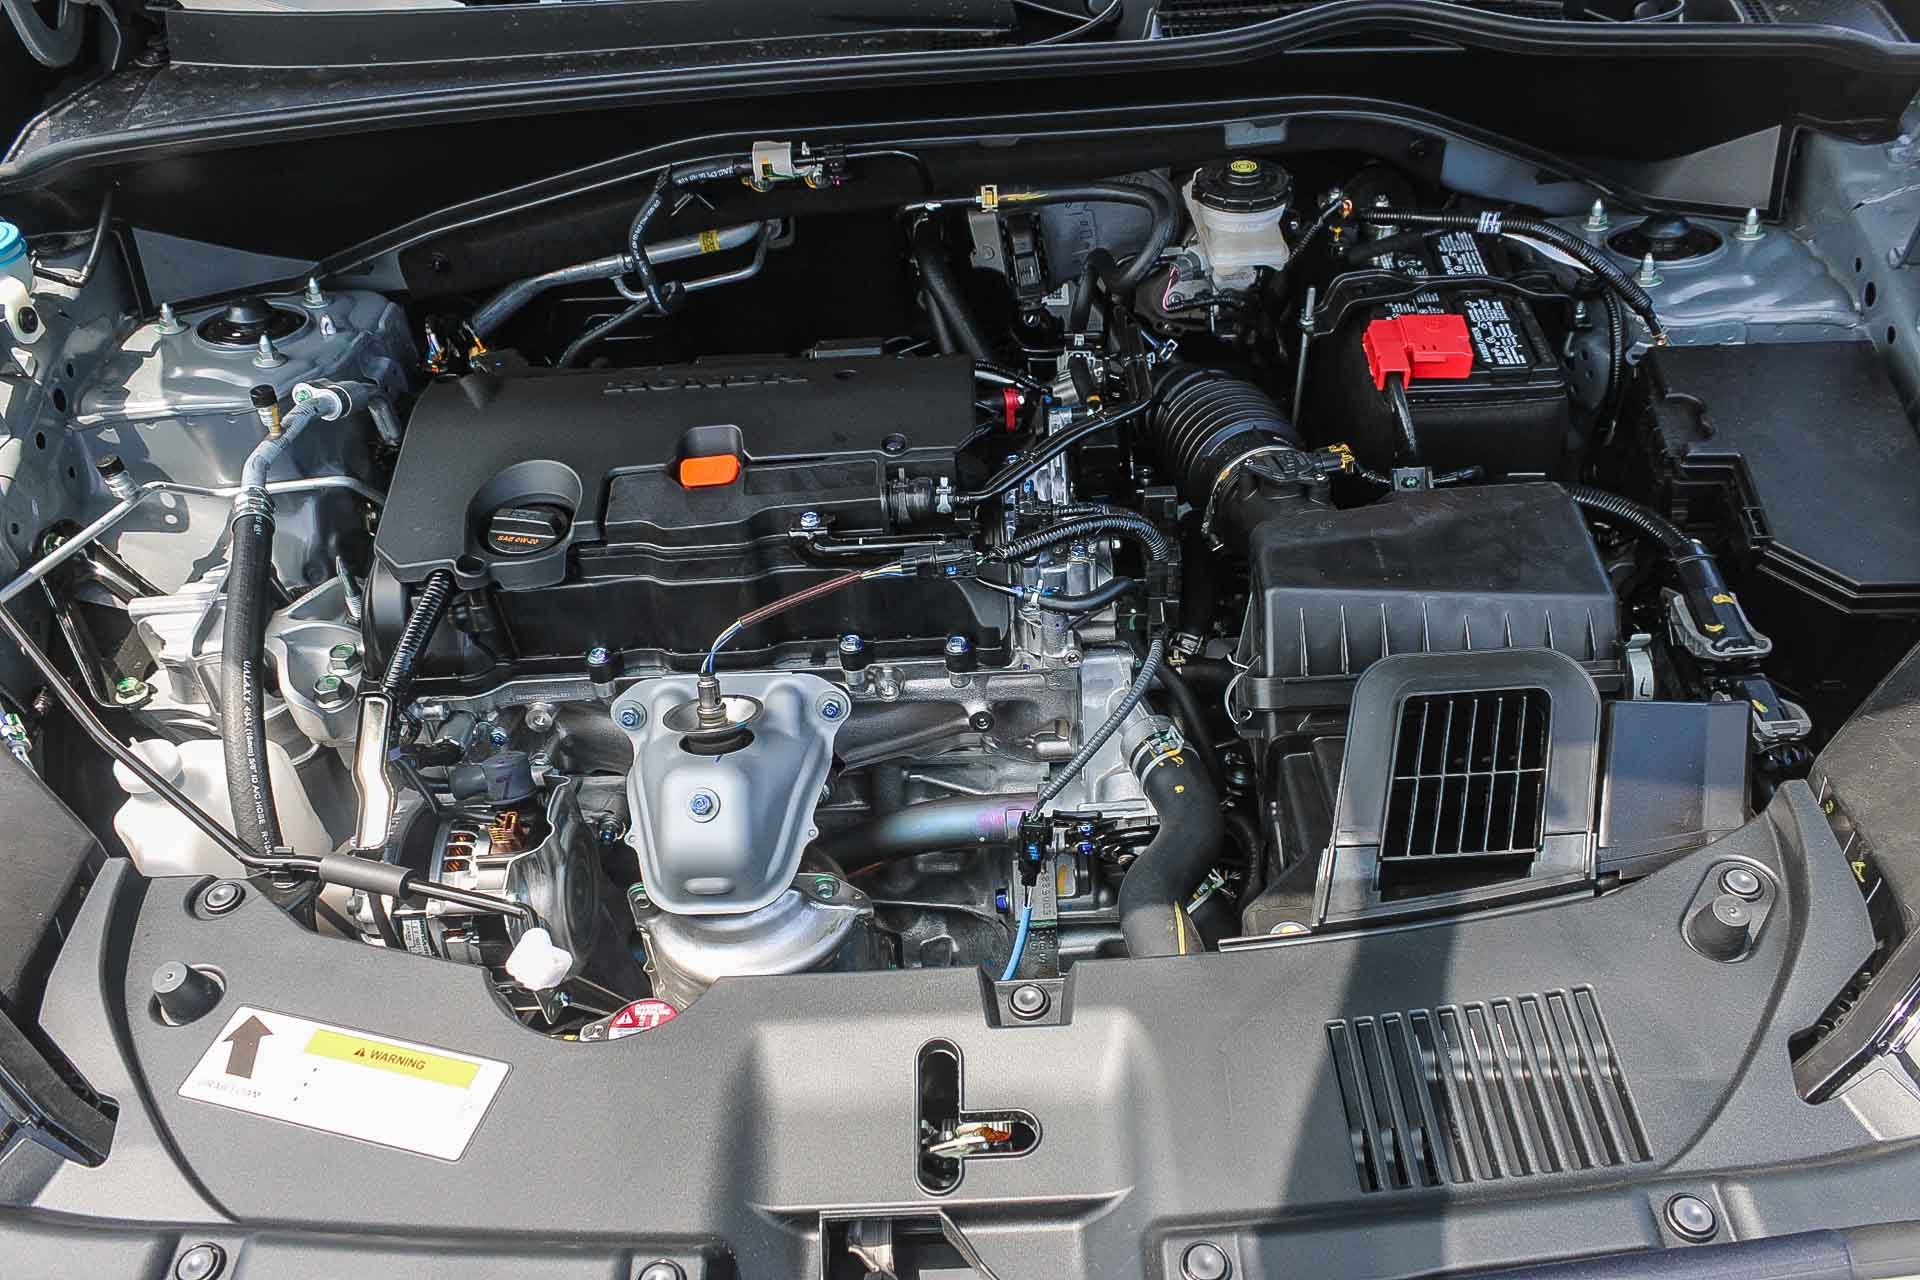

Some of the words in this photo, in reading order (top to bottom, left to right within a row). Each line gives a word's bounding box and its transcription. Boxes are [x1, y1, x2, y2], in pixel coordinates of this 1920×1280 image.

[243, 660, 252, 704] GALAXY
[255, 801, 265, 825] HOSE
[370, 1049, 426, 1070] WARNING
